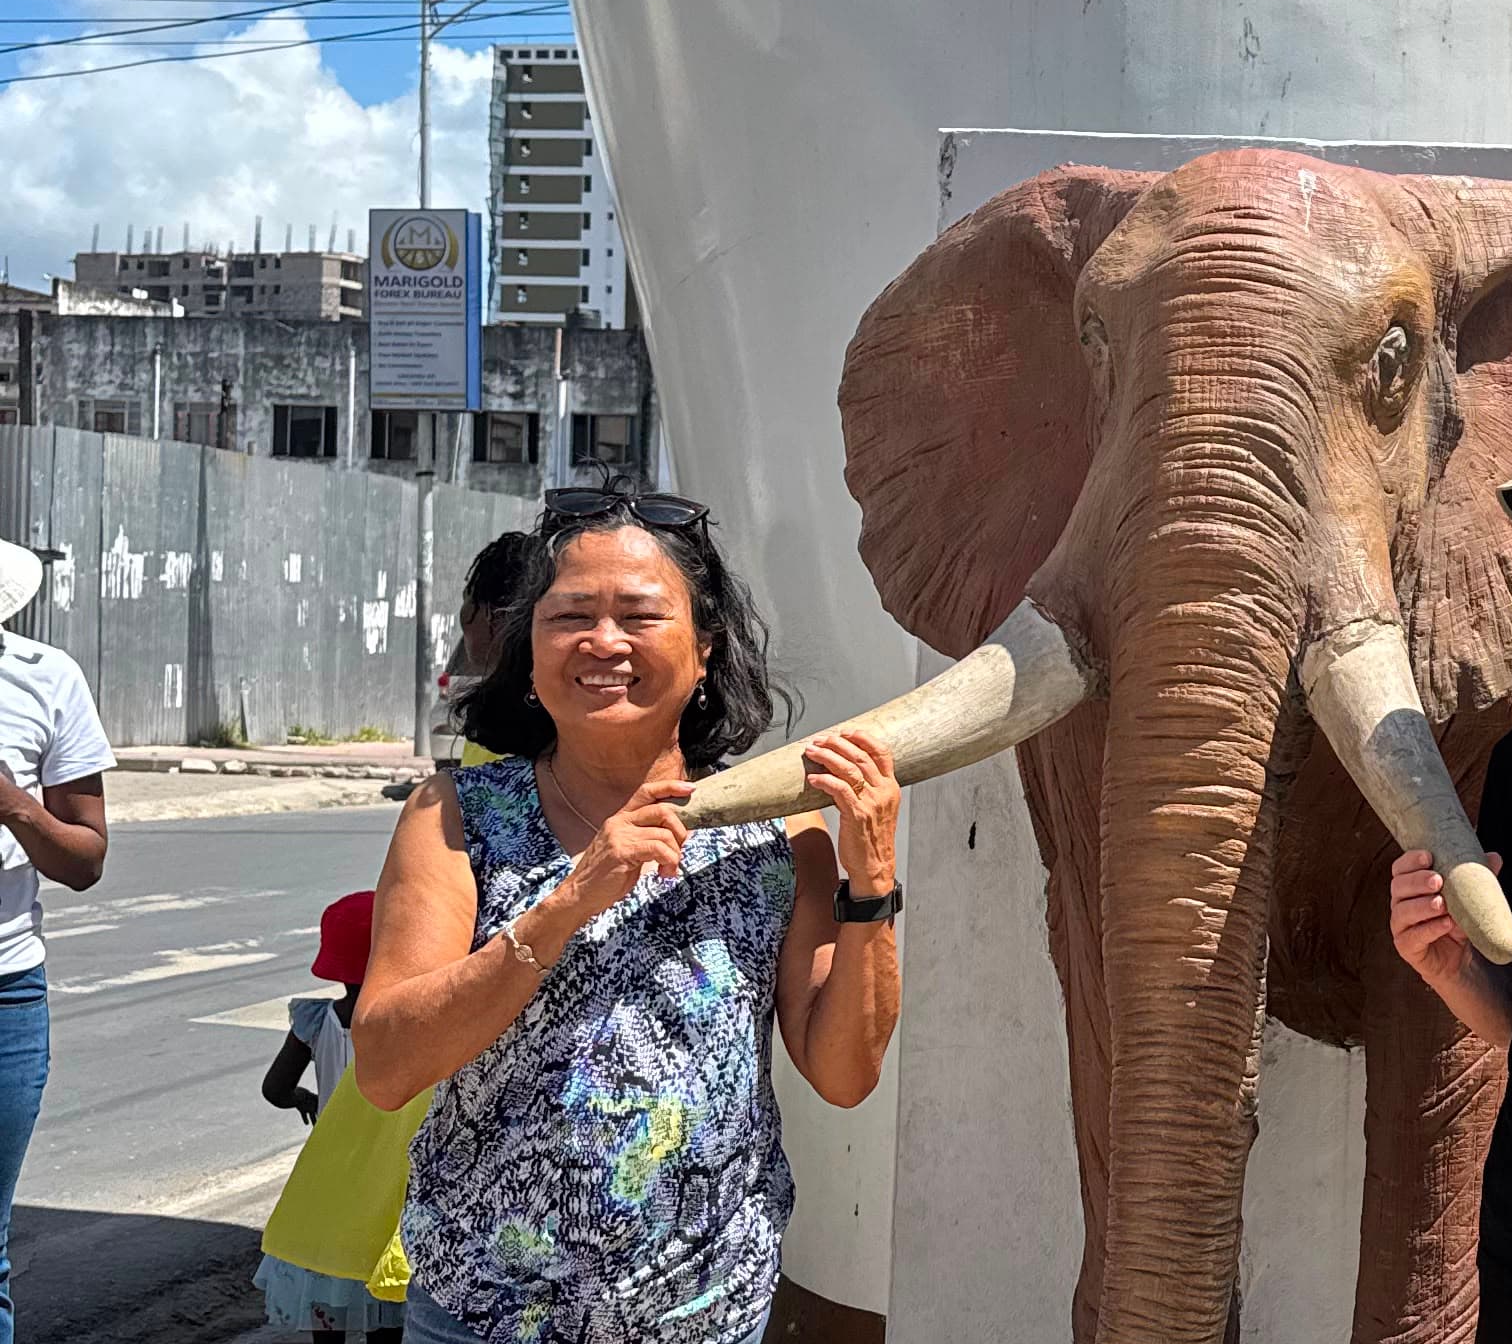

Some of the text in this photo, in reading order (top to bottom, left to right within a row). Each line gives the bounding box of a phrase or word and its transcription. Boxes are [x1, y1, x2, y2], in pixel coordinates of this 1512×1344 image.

[374, 275, 463, 289] MARIGOLD
[374, 289, 462, 301] FOREX BUREAU
